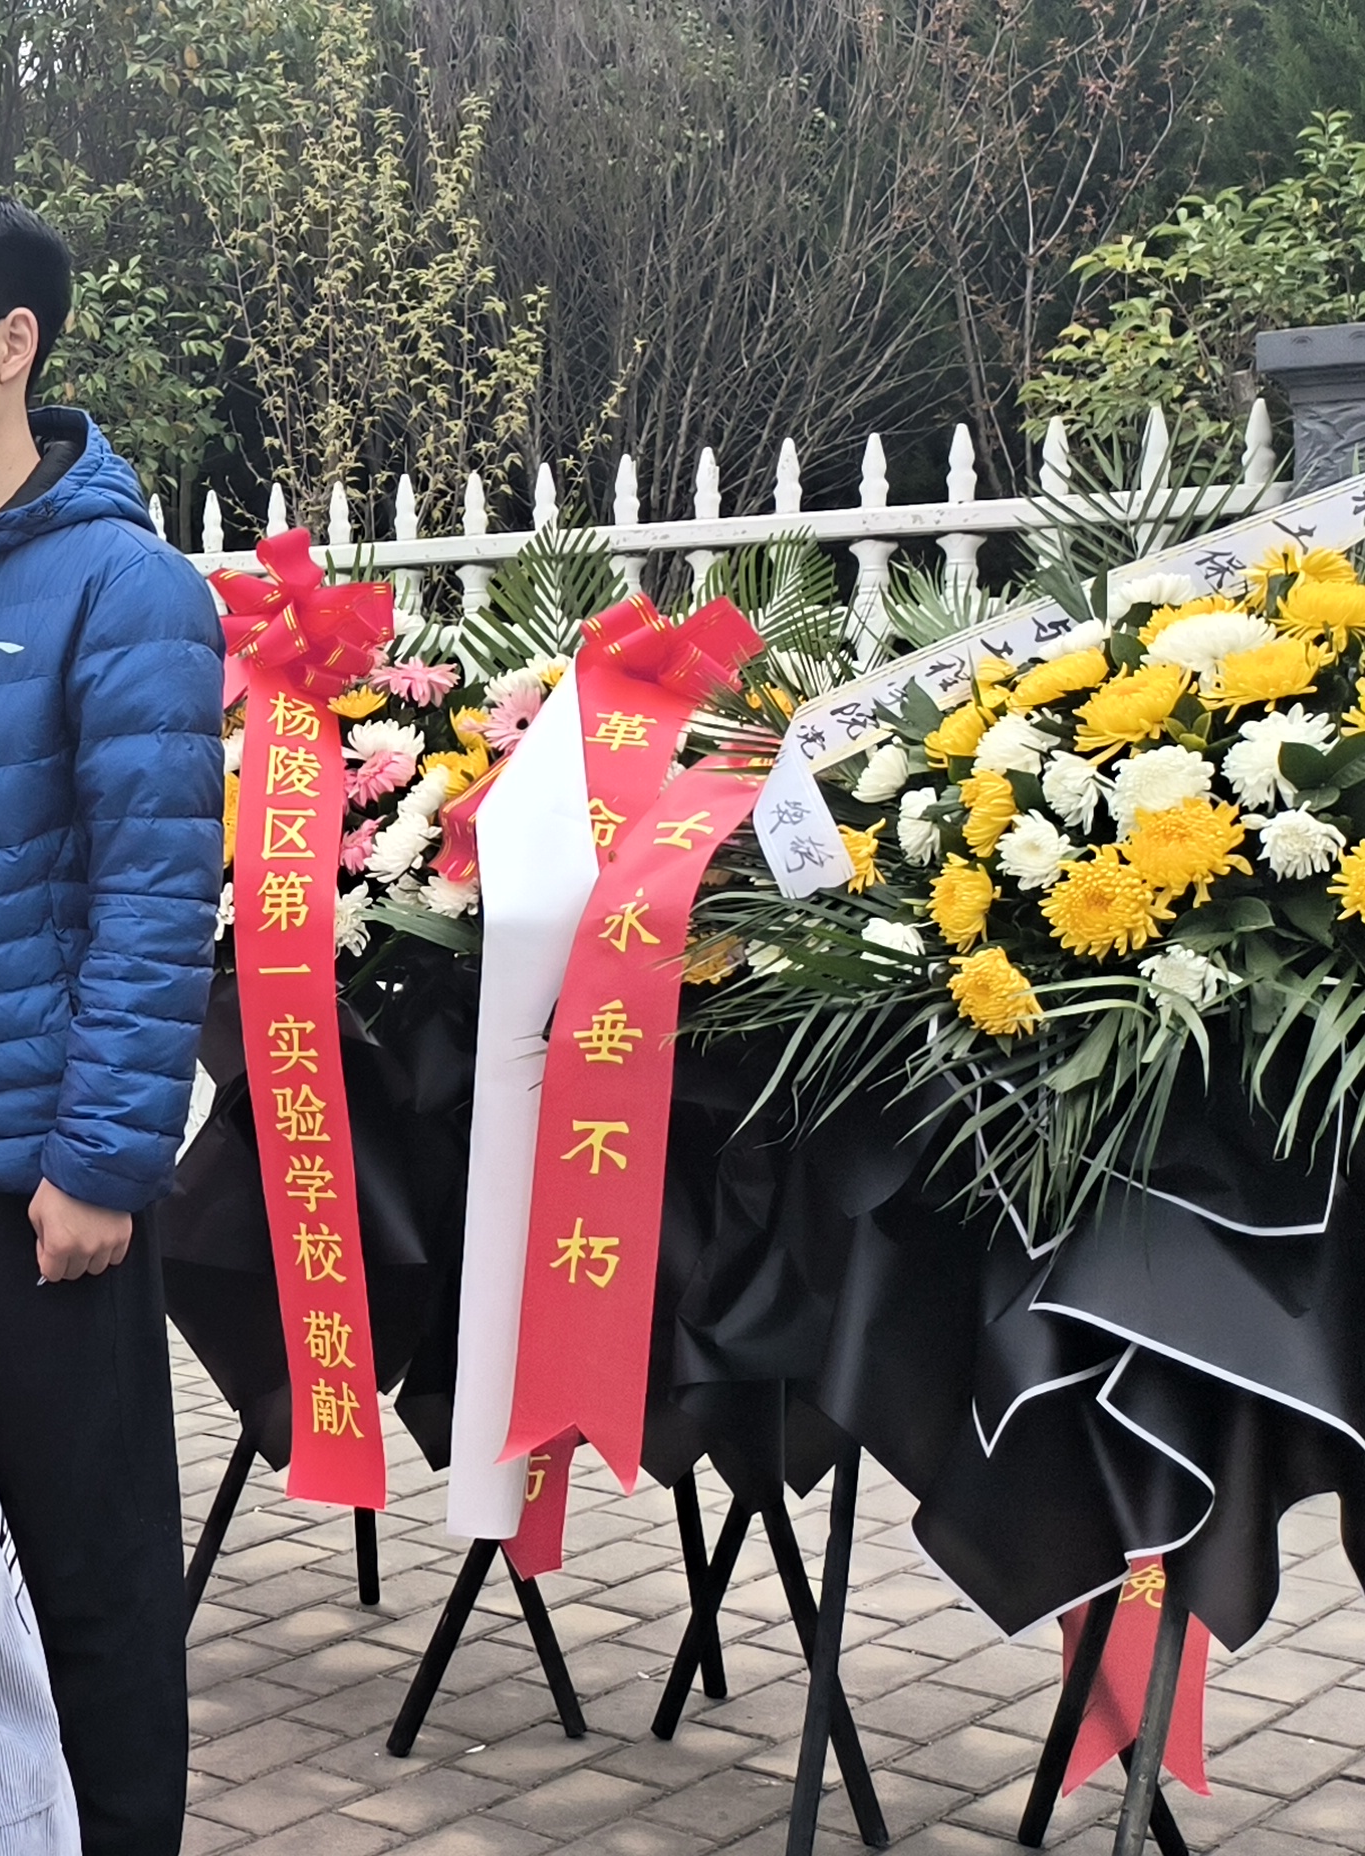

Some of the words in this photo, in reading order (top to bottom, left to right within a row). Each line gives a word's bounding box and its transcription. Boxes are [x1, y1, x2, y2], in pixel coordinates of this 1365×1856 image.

[255, 690, 347, 1284] 杨陵区第一实验学校
[302, 1309, 365, 1440] 敬献
[549, 710, 715, 1289] 革命士永垂不朽
